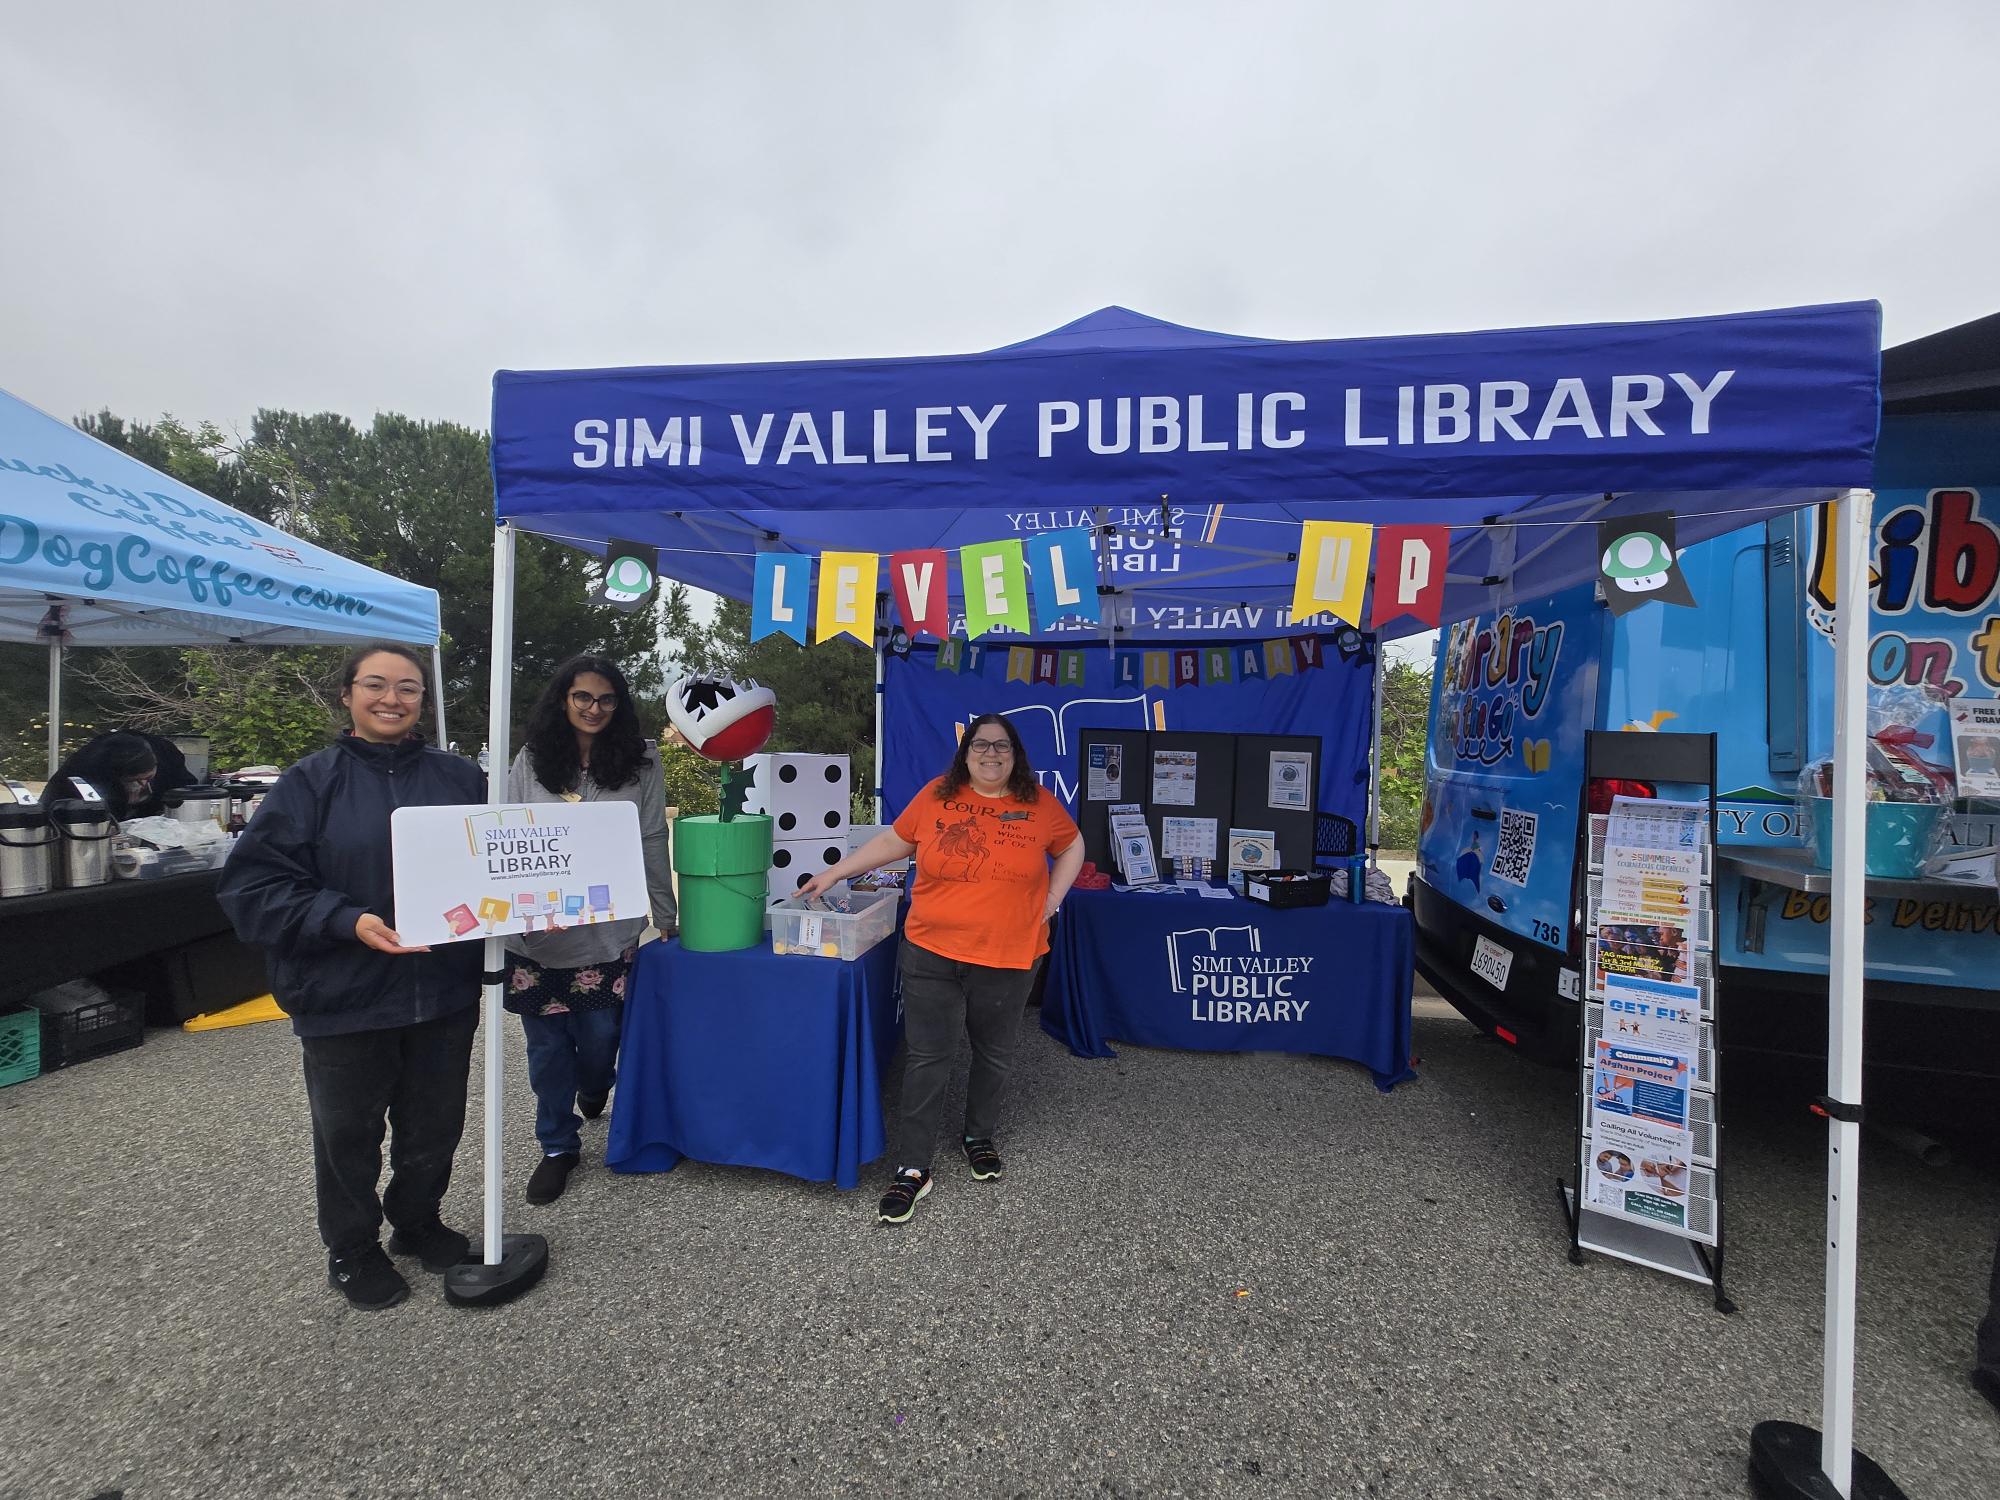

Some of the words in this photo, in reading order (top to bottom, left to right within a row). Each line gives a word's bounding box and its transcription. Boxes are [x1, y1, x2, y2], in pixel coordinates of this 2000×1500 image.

[573, 416, 702, 468] SIMI
[730, 404, 1007, 465] VALLEY
[1038, 391, 1306, 458] PUBLIC
[1345, 370, 1736, 447] LIBRARY
[0, 458, 150, 511] ucky
[144, 491, 262, 538] Dog
[68, 492, 253, 550] Coffee
[771, 544, 1081, 623] LEVEL
[1312, 536, 1432, 604] UP
[942, 641, 980, 670] AT
[1013, 651, 1078, 680] THE
[1123, 639, 1318, 682] LIBRARY
[1868, 634, 1964, 700] on
[1973, 707, 1996, 716] FREE
[943, 800, 1037, 823] COURE
[485, 828, 516, 841] SIMI
[522, 826, 570, 839] VALLEY
[487, 838, 560, 857] PUBLIC
[488, 854, 573, 874] LIBRARY
[490, 870, 571, 881] www.simivalleylibrary.org
[1532, 919, 1560, 945] 736
[1192, 955, 1233, 973] SIMI
[1237, 957, 1314, 974] VALLEY
[1600, 950, 1615, 958] TAG
[1473, 950, 1506, 983] 1690450
[1192, 974, 1293, 998] PUBLIC
[1192, 999, 1310, 1023] LIBRARY
[1609, 1000, 1650, 1016] GET
[1600, 1058, 1635, 1072] Afghan
[1637, 1067, 1673, 1082] Project
[1615, 1051, 1674, 1067] Community
[1600, 1121, 1626, 1133] Calling
[1638, 1131, 1681, 1147] Volunteers
